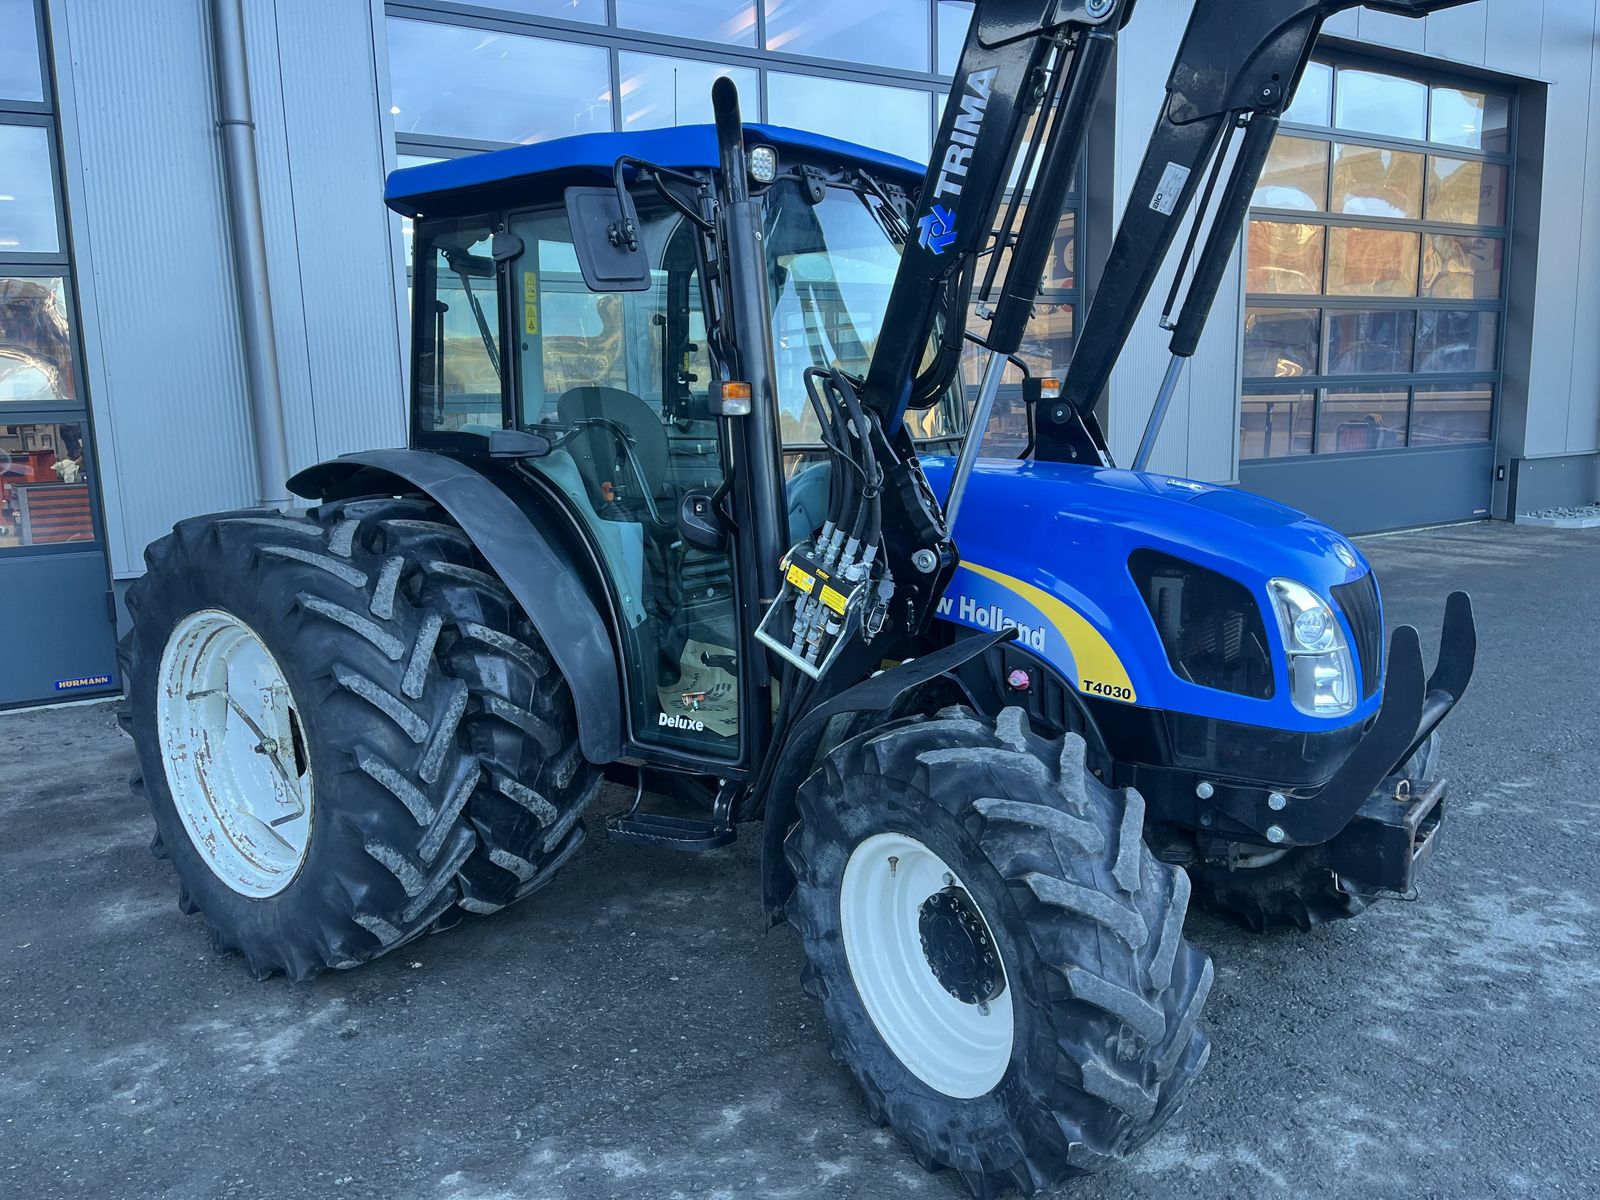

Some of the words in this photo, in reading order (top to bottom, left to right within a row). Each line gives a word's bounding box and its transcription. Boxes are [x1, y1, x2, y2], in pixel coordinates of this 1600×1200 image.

[934, 67, 998, 198] TRIMA
[960, 595, 1045, 652] Holland
[1083, 679, 1131, 700] T4030
[658, 712, 704, 731] Deluxe
